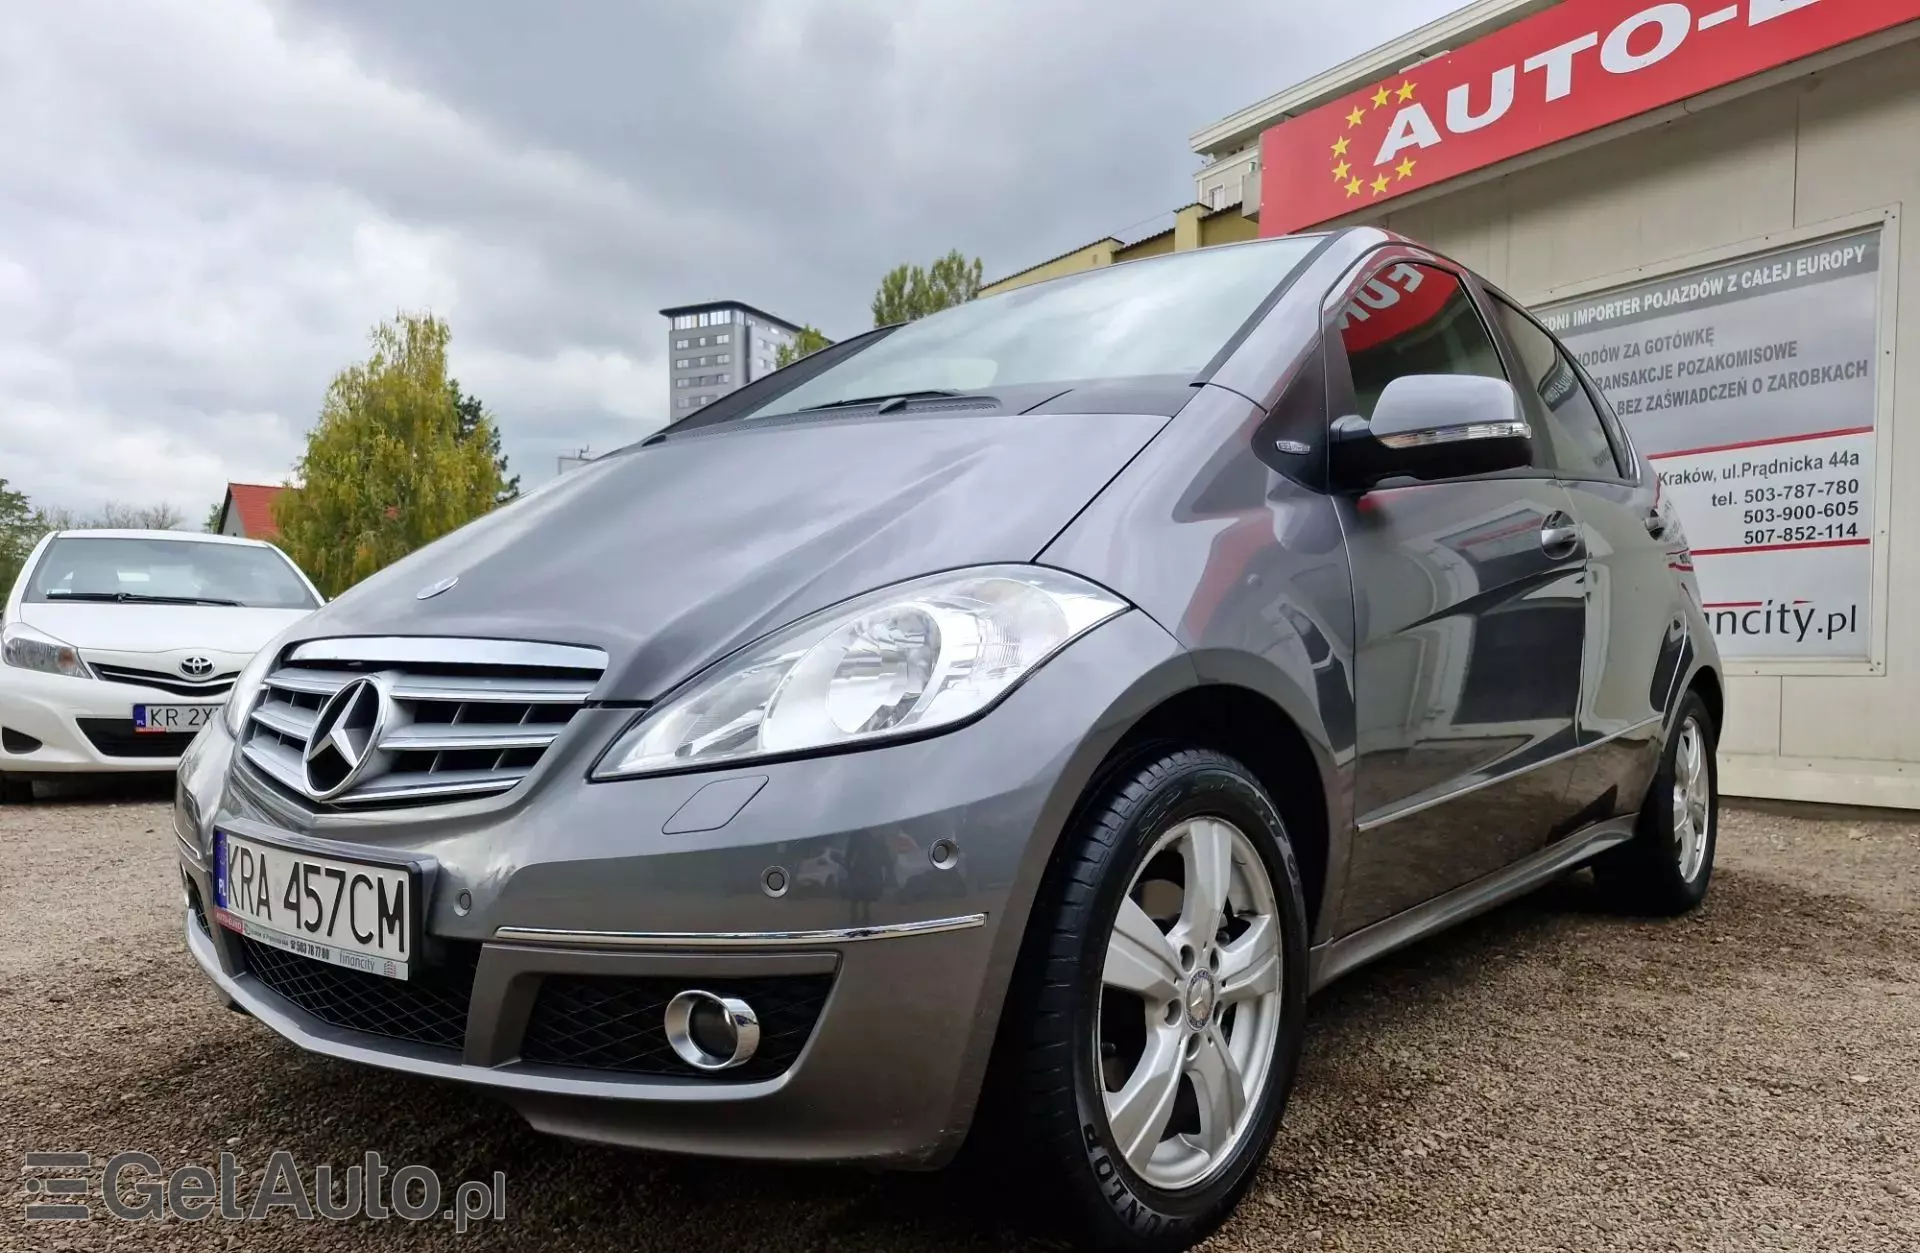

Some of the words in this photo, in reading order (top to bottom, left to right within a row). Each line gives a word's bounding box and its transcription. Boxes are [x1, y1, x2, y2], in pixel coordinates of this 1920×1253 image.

[1573, 297, 1641, 327] IMPORTER
[1644, 276, 1724, 310] POJAZDÓW
[1727, 274, 1738, 293] Z
[1741, 262, 1792, 288] CAŁEJ
[1796, 244, 1866, 277] EUROPY
[1623, 343, 1641, 360] ZA
[1645, 326, 1715, 355] GOTÓWKĘ
[1595, 364, 1673, 391] RANSAKCJE
[1677, 340, 1798, 378] POZAKOMISOWE
[1617, 398, 1642, 416] BEZ
[1645, 376, 1747, 412] ZAŚWIADCZEŃ
[1752, 377, 1763, 394] O
[1767, 360, 1868, 392] ZAROBKACH
[1658, 467, 1717, 486] Kraków,
[1722, 454, 1823, 480] ul.Prądnicka
[1828, 450, 1860, 467] 44a
[1711, 492, 1738, 507] tel.
[1743, 478, 1859, 504] 503-787-780
[1743, 501, 1859, 524] 503-900-605
[1743, 522, 1858, 545] 507-852-114
[150, 708, 179, 726] KR
[188, 708, 218, 726] 2X
[218, 878, 227, 897] PL
[227, 842, 272, 921] KRA
[283, 862, 405, 953] 457CM
